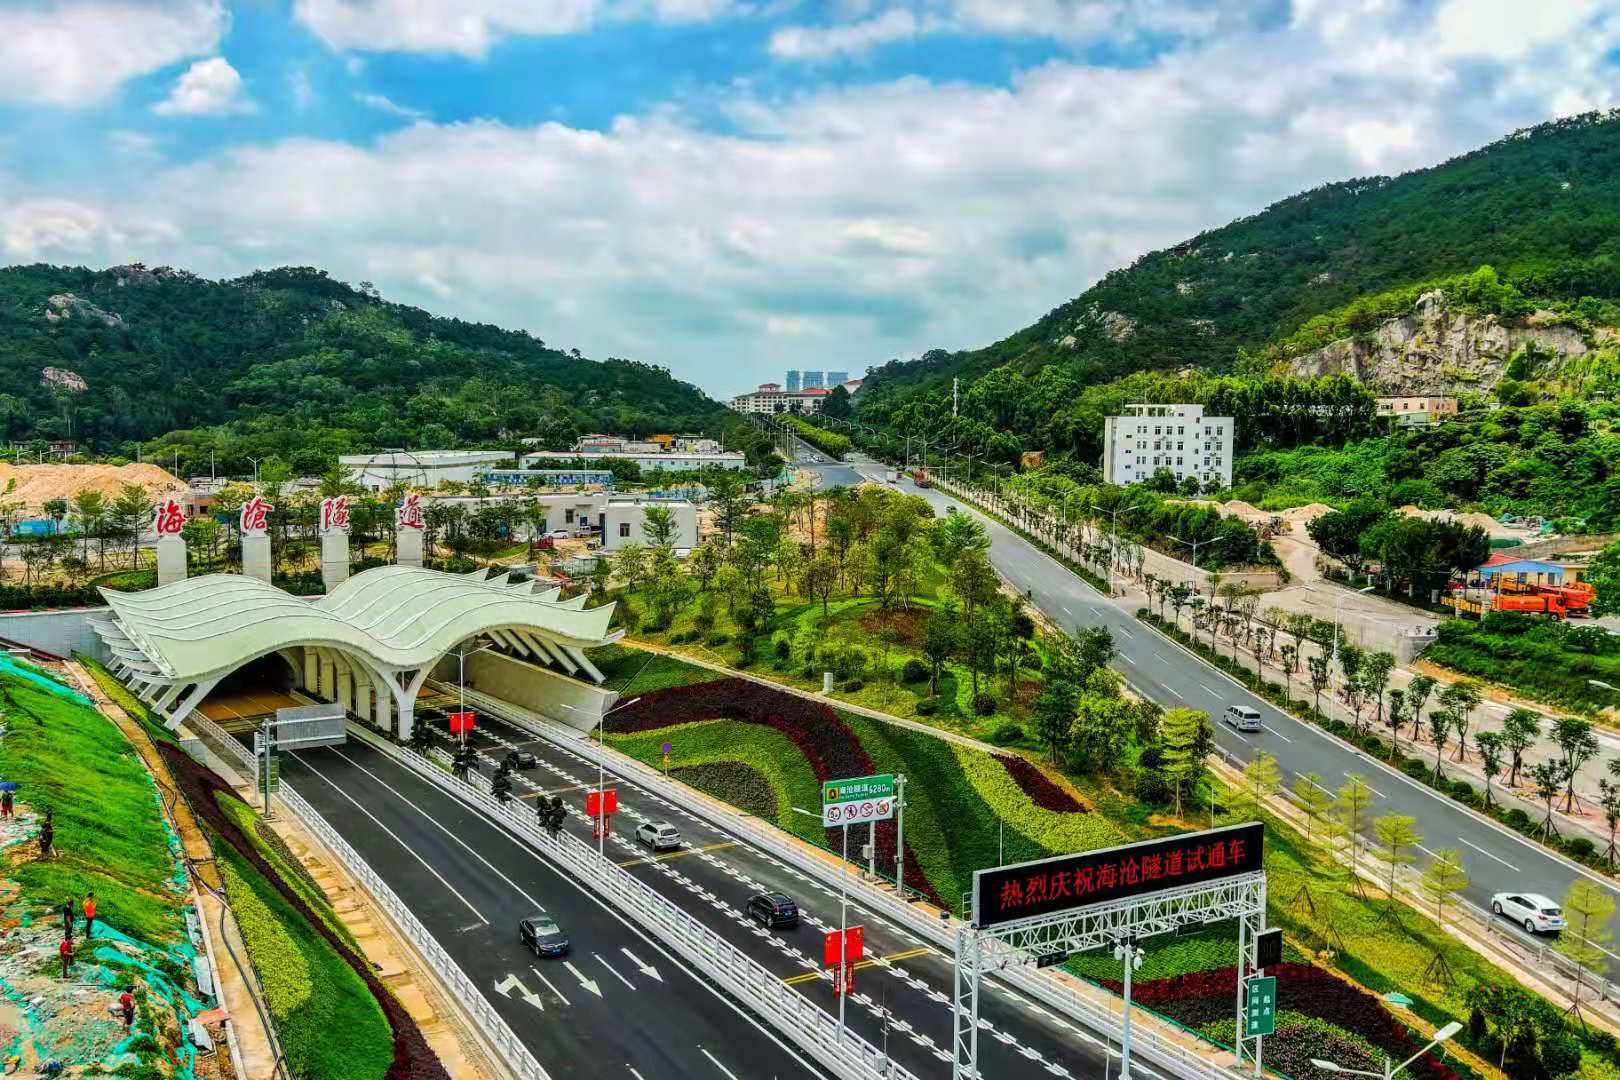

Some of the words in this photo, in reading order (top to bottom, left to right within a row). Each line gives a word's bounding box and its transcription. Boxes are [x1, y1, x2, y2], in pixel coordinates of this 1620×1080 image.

[1000, 839, 1247, 911] 热烈庆祝海沧隧道试通车
